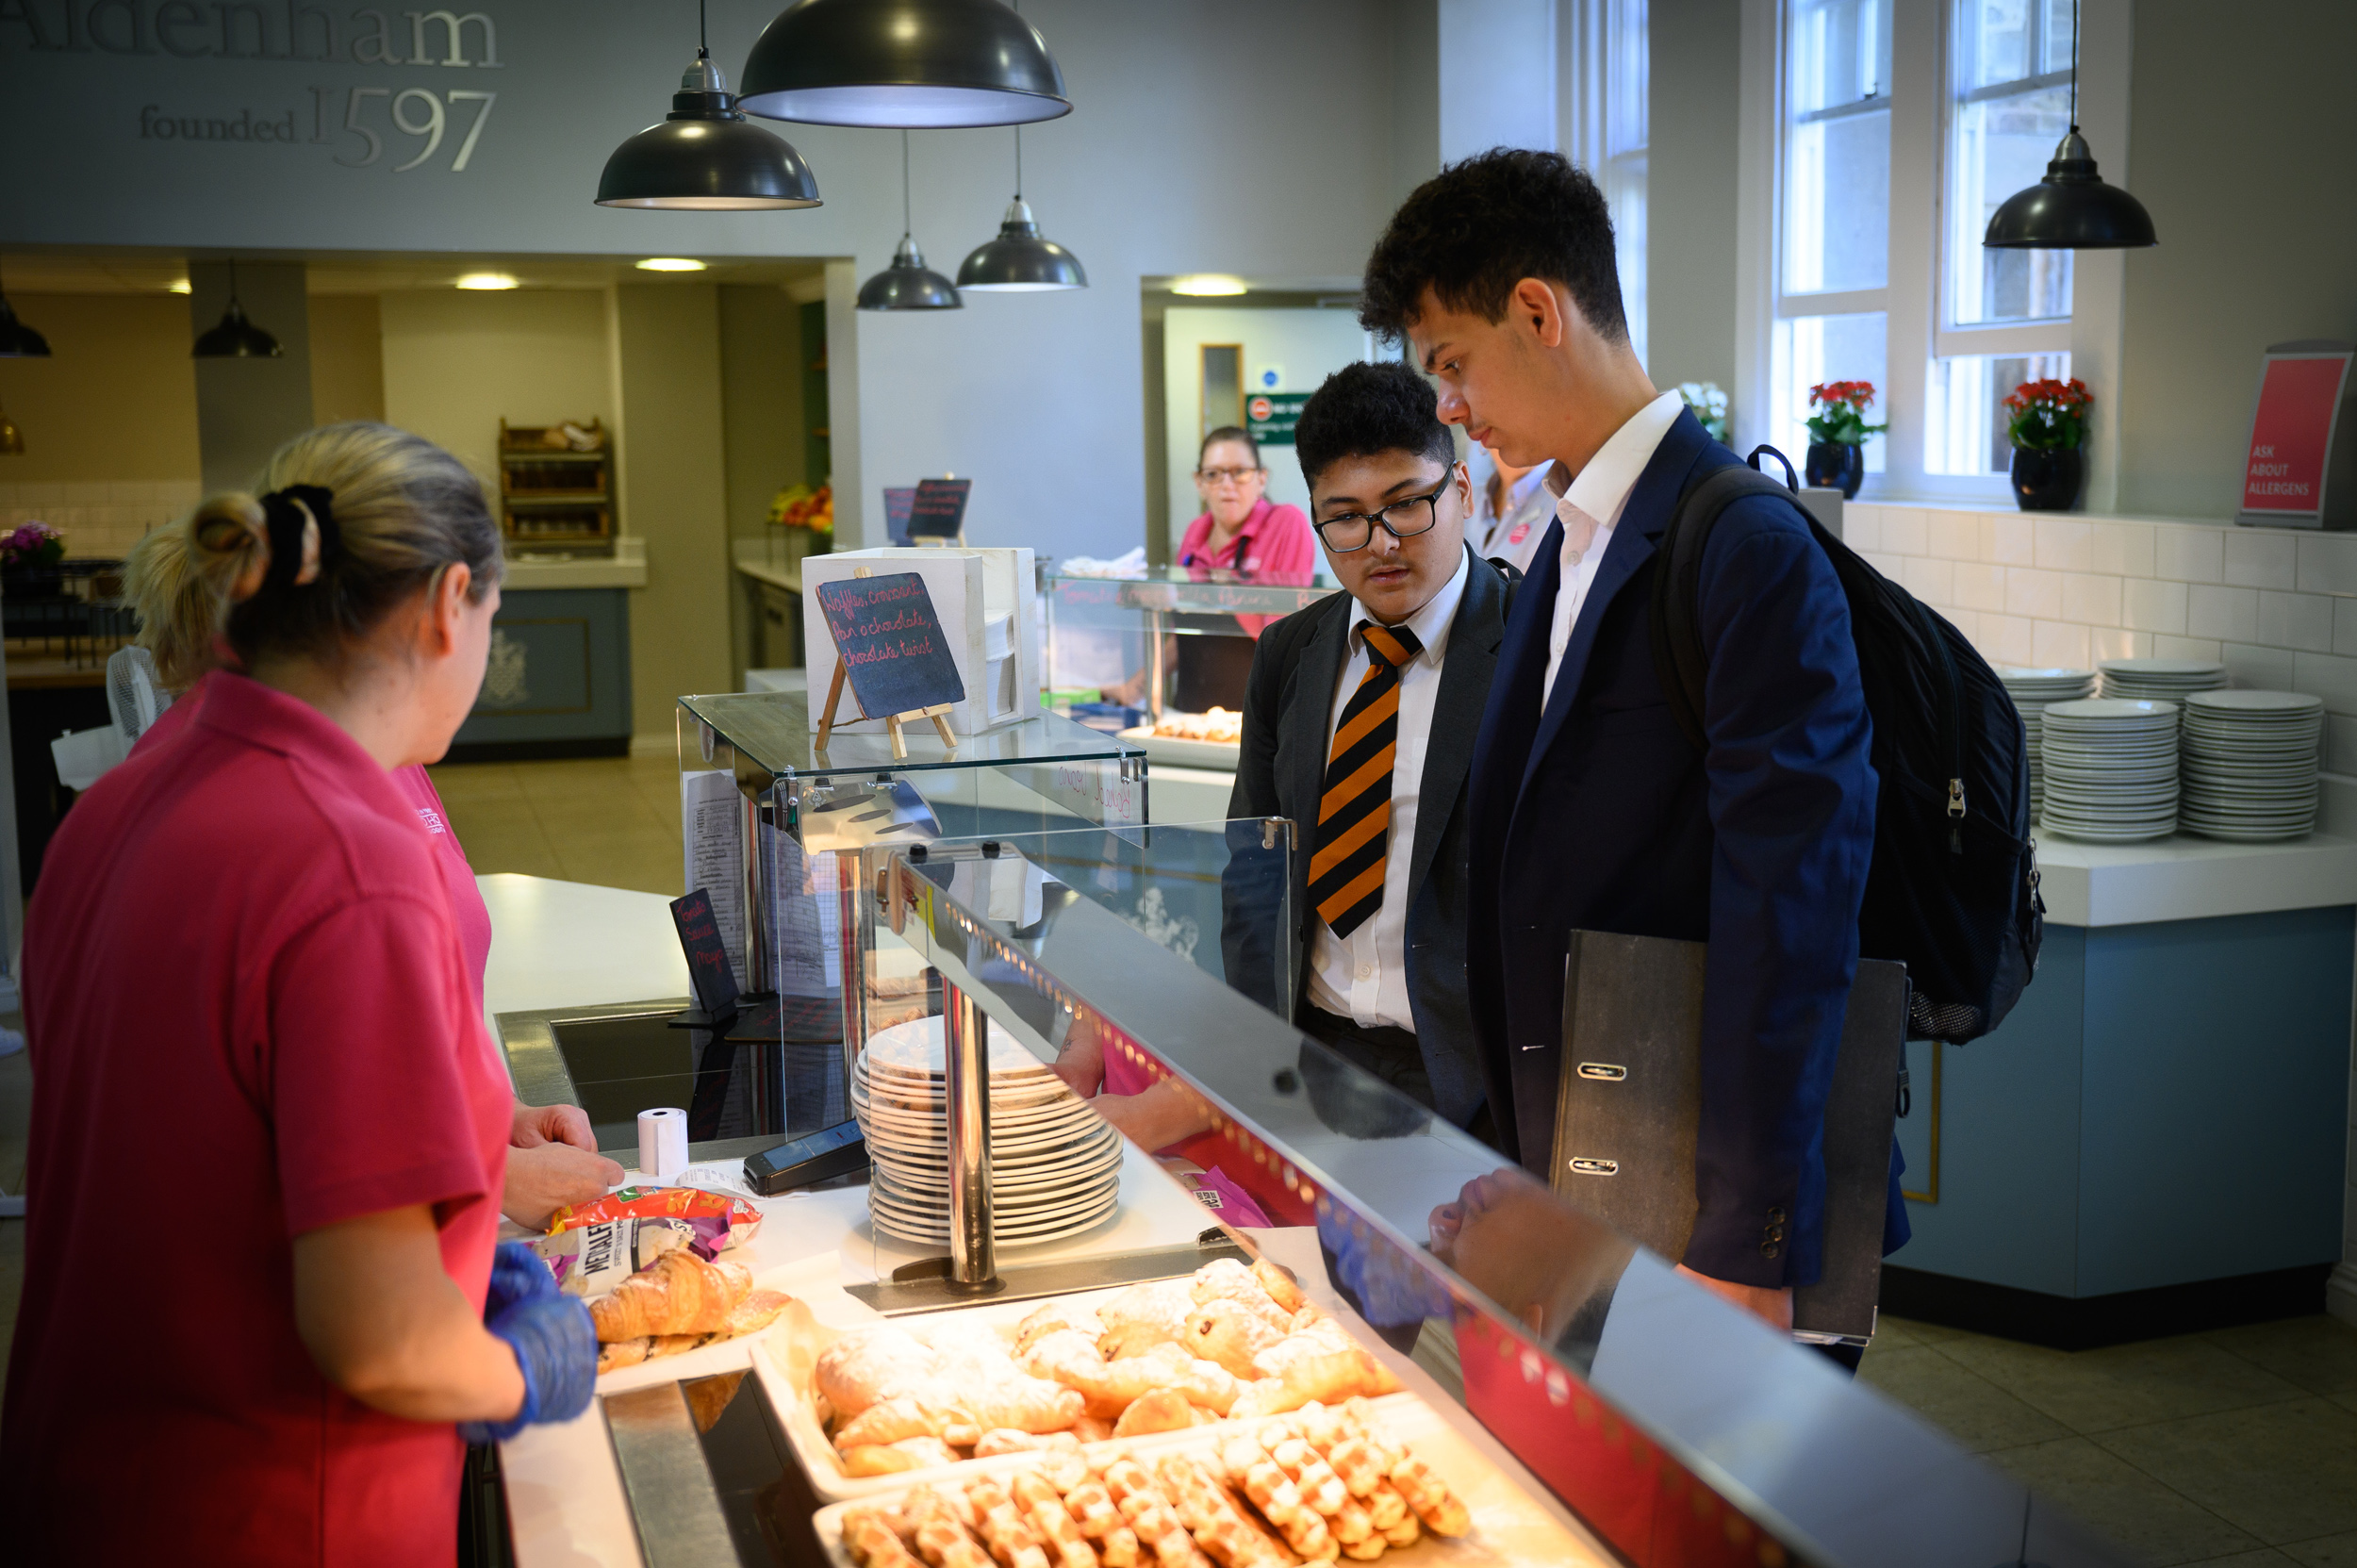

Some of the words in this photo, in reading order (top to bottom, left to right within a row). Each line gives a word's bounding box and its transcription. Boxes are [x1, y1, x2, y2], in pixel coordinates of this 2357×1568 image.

[138, 104, 300, 143] founded
[309, 86, 498, 173] 1597
[2252, 445, 2274, 458] ASK
[2250, 463, 2289, 477] ABOUT
[2248, 482, 2309, 495] ALLERGENS
[843, 642, 899, 667] chocolate
[899, 635, 933, 656] twist
[677, 898, 707, 922] Tomato
